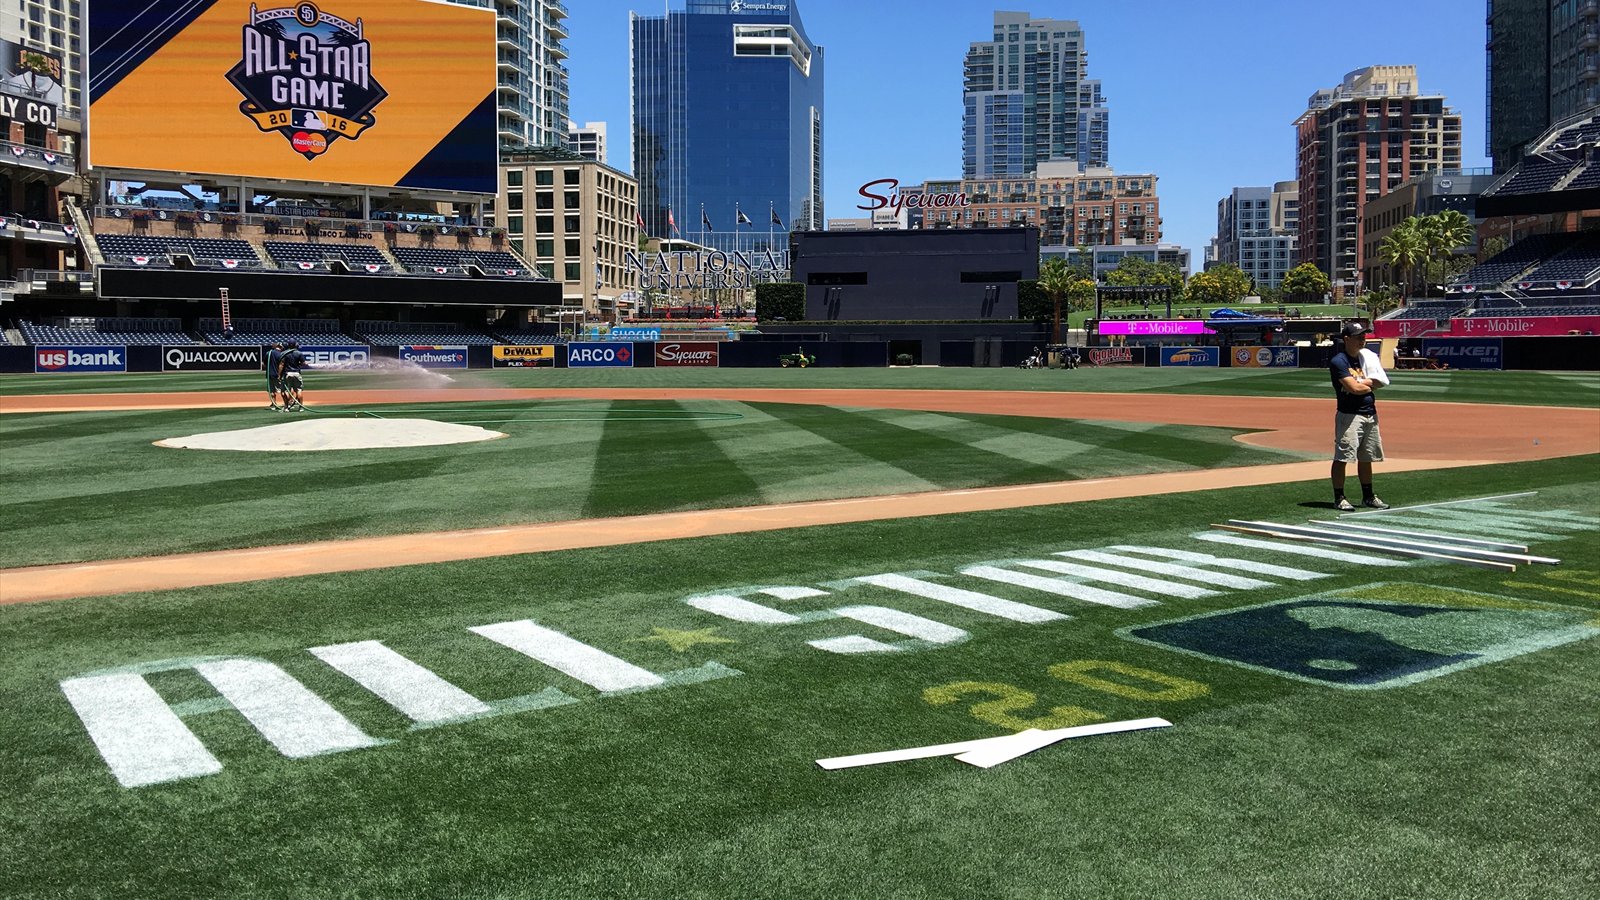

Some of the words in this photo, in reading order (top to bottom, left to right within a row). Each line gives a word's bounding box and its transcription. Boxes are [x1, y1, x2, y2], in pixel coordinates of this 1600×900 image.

[766, 3, 786, 11] Energy
[245, 26, 292, 77] ALL
[300, 35, 369, 90] STAR
[271, 75, 345, 109] GAME
[26, 102, 56, 126] CO.
[269, 112, 287, 125] 20
[331, 117, 347, 131] 16
[293, 138, 326, 147] MasterCard
[856, 178, 971, 217] Sycuan
[640, 271, 785, 289] UNIVERSITY
[304, 351, 367, 365] GEICO
[404, 352, 457, 363] Southwest
[570, 348, 615, 362] ARCO
[661, 344, 712, 364] Sycuan
[1426, 346, 1499, 356] FALKEN
[166, 349, 258, 368] QUALCOMM
